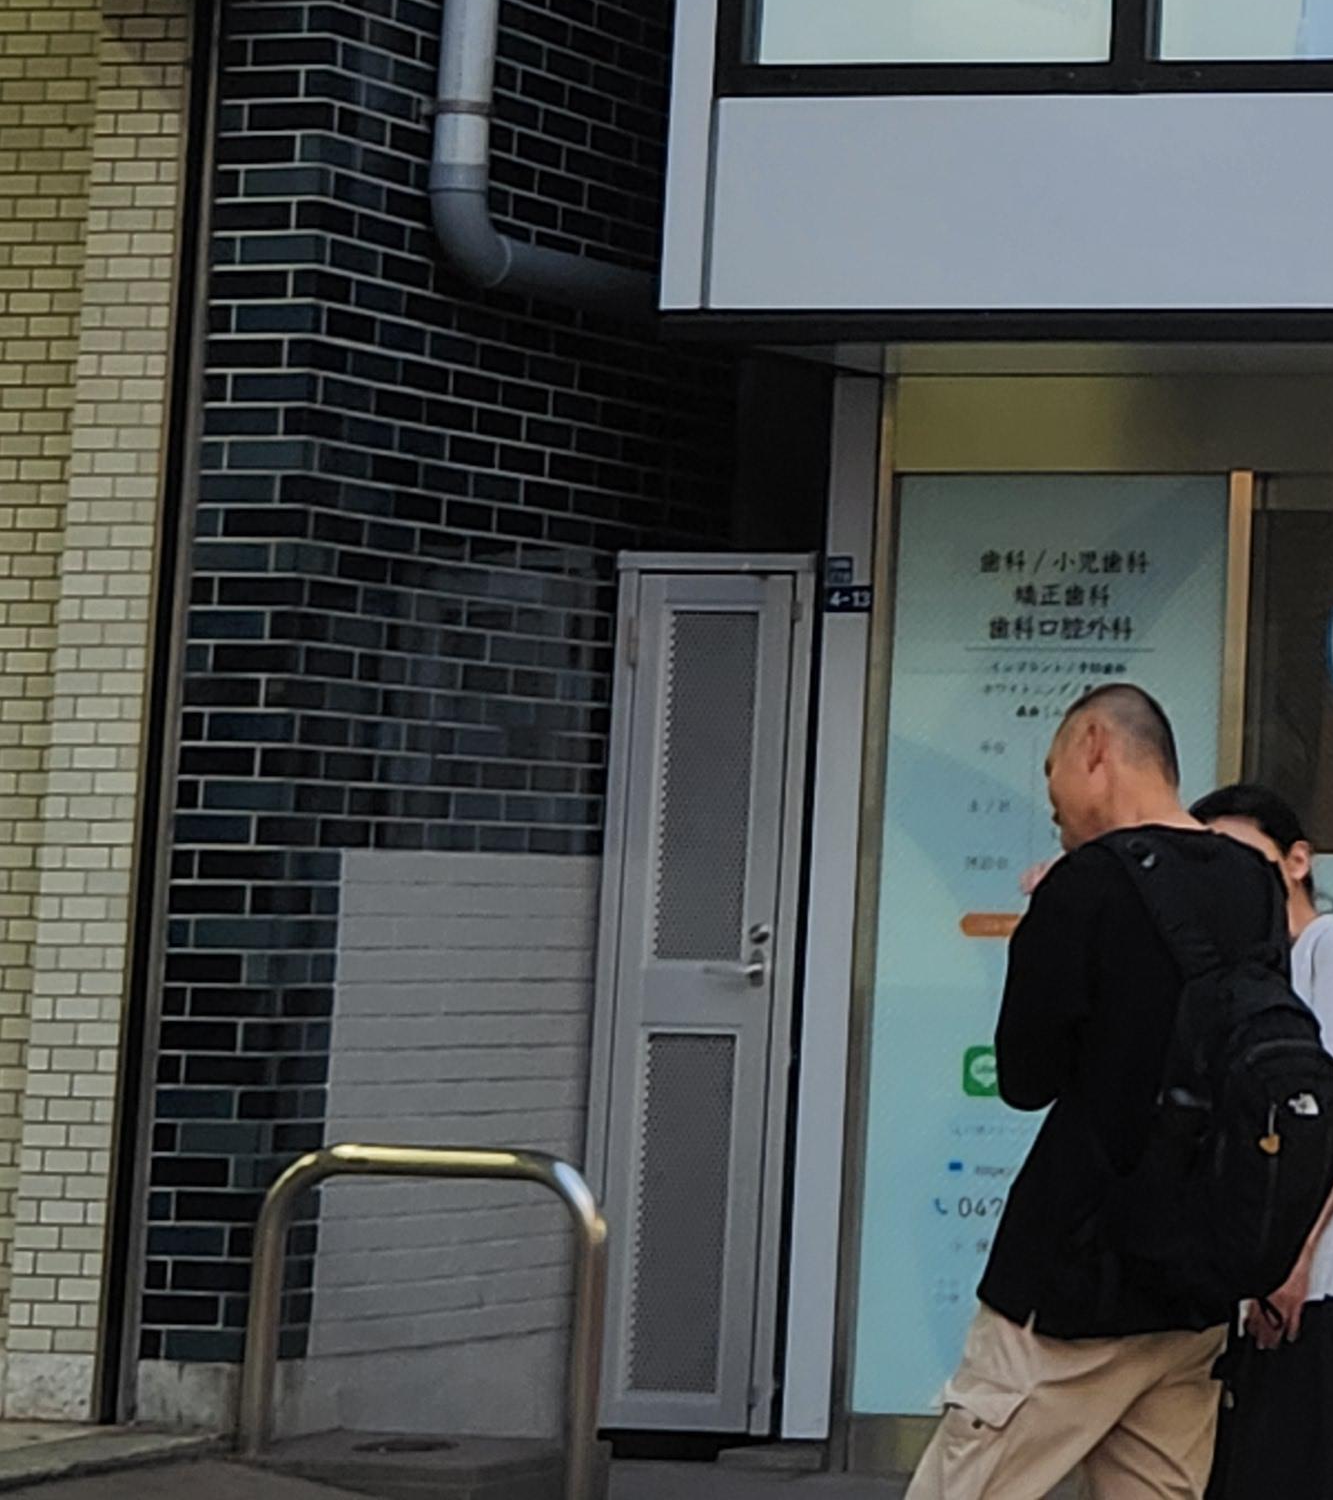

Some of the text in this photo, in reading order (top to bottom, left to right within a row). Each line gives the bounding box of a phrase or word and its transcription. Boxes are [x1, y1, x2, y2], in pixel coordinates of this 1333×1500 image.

[829, 590, 871, 608] 4-13
[1014, 583, 1110, 607] 矯正歯科
[988, 616, 1132, 640] 歯科口腔外科
